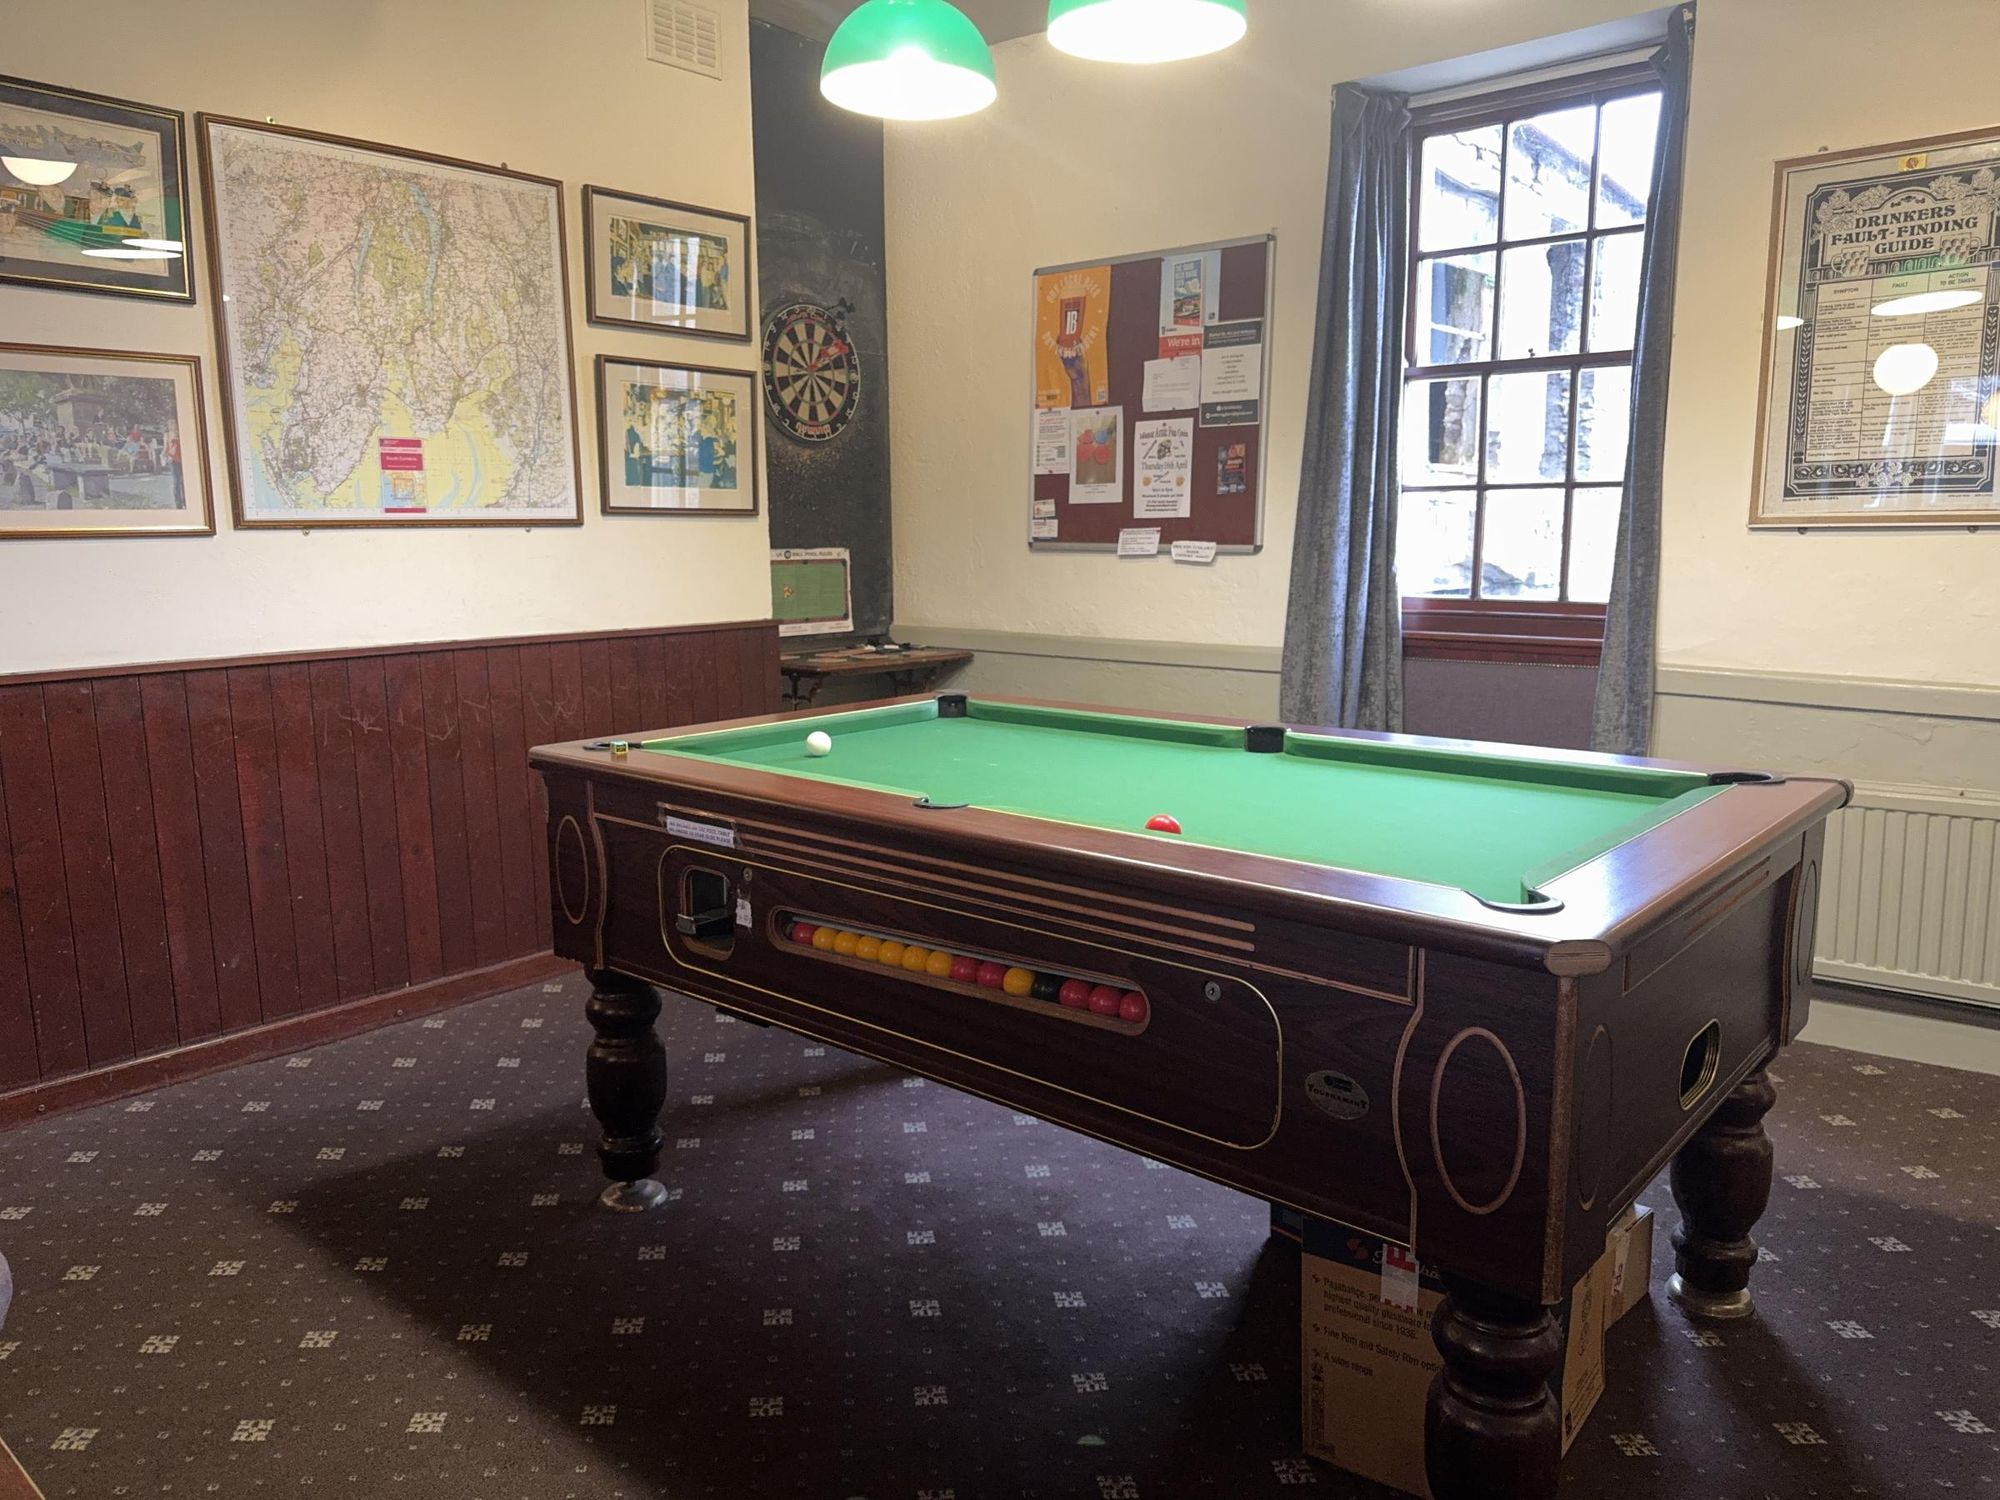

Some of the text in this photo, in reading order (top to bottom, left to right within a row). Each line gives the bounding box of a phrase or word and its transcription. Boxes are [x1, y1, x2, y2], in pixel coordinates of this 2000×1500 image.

[1855, 204, 1956, 229] DRINKERS
[1831, 216, 1978, 246] FAULT-FINDING
[1875, 237, 1934, 254] GUIDE
[1949, 271, 1969, 279] ACTION
[1957, 277, 1976, 285] TAKEN
[1833, 287, 1859, 295] SYMPTOM
[1892, 281, 1909, 289] FAULT
[1167, 336, 1191, 347] We're
[1192, 336, 1200, 345] in
[1353, 1300, 1379, 1316] quality
[1372, 1317, 1393, 1332] since
[1358, 1339, 1374, 1351] and
[1375, 1343, 1400, 1361] Safety
